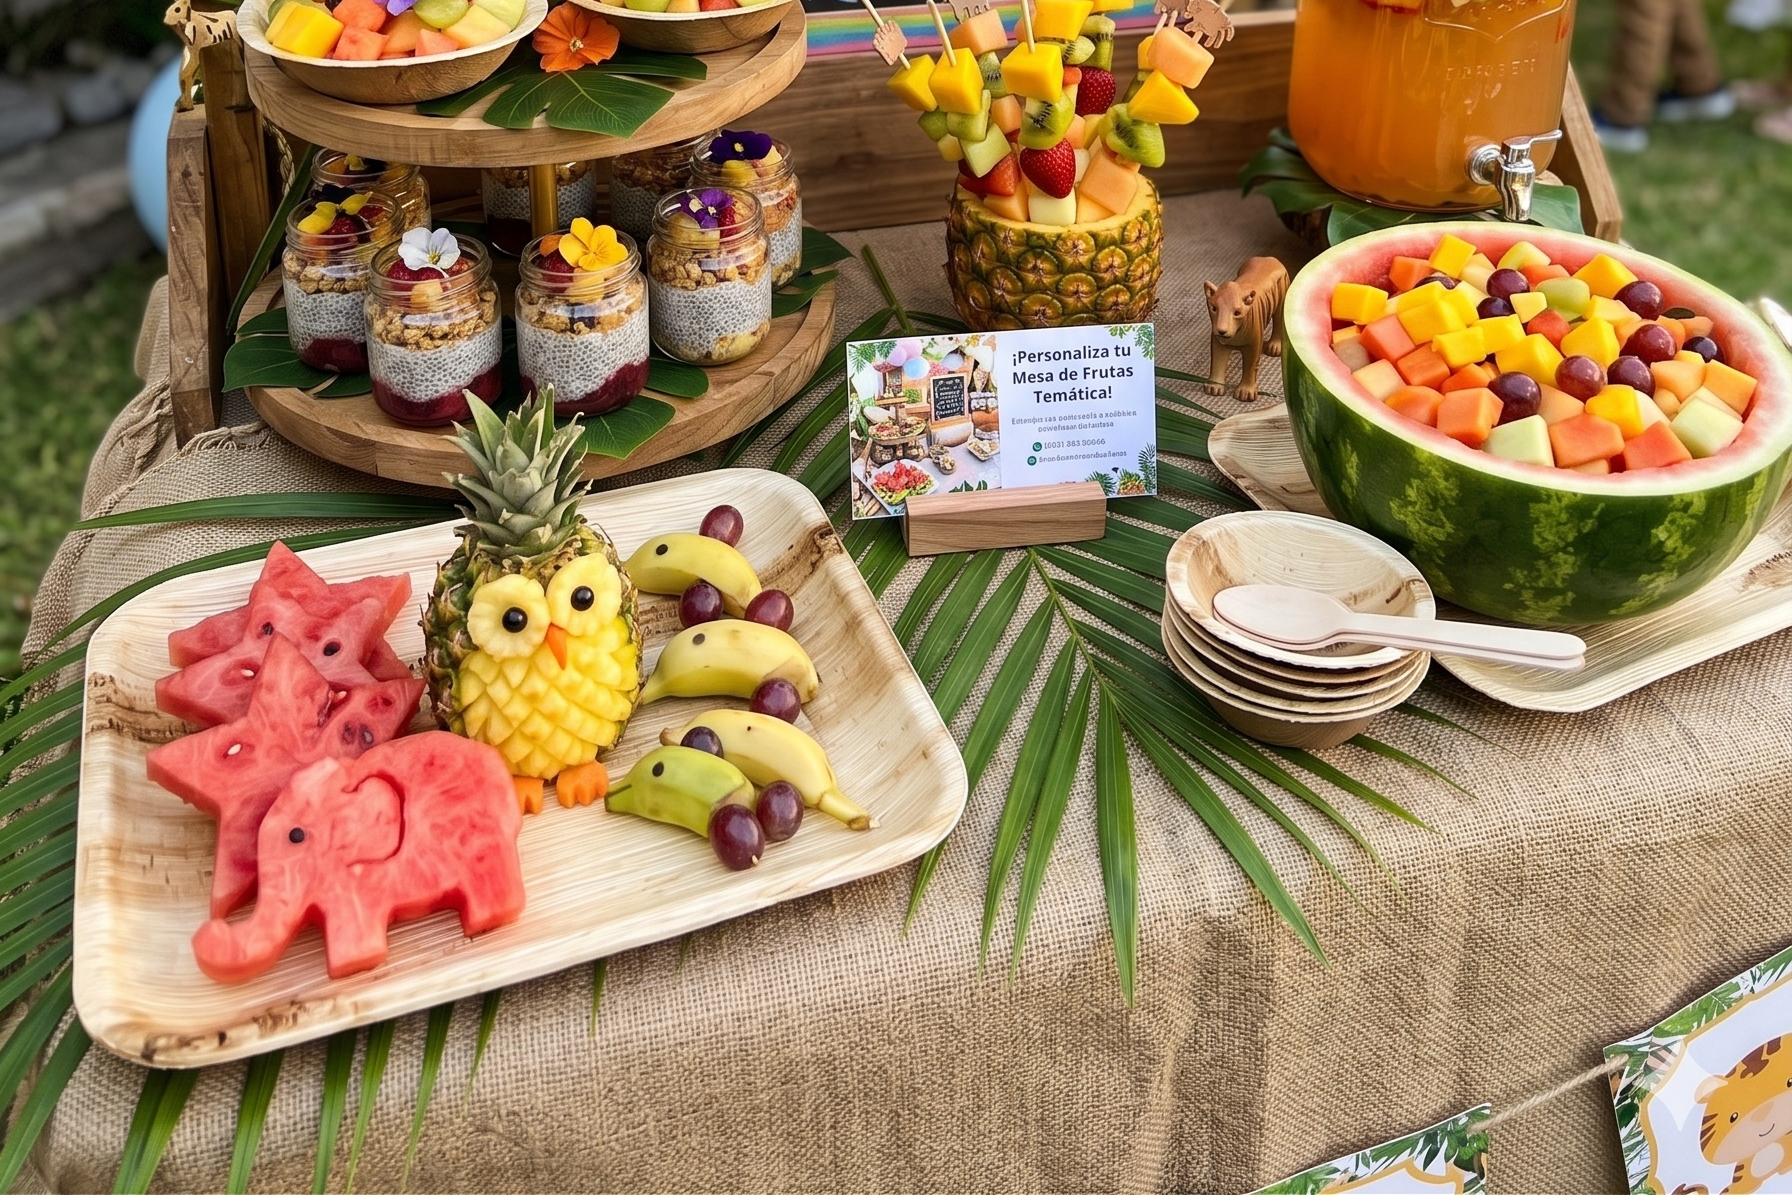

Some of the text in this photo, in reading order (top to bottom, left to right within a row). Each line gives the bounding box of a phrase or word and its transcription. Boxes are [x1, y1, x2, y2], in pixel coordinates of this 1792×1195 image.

[1013, 345, 1131, 366] ¡Personaliza tu
[1012, 365, 1134, 384] Mesa de Frutas
[1033, 386, 1112, 403] Temática!
